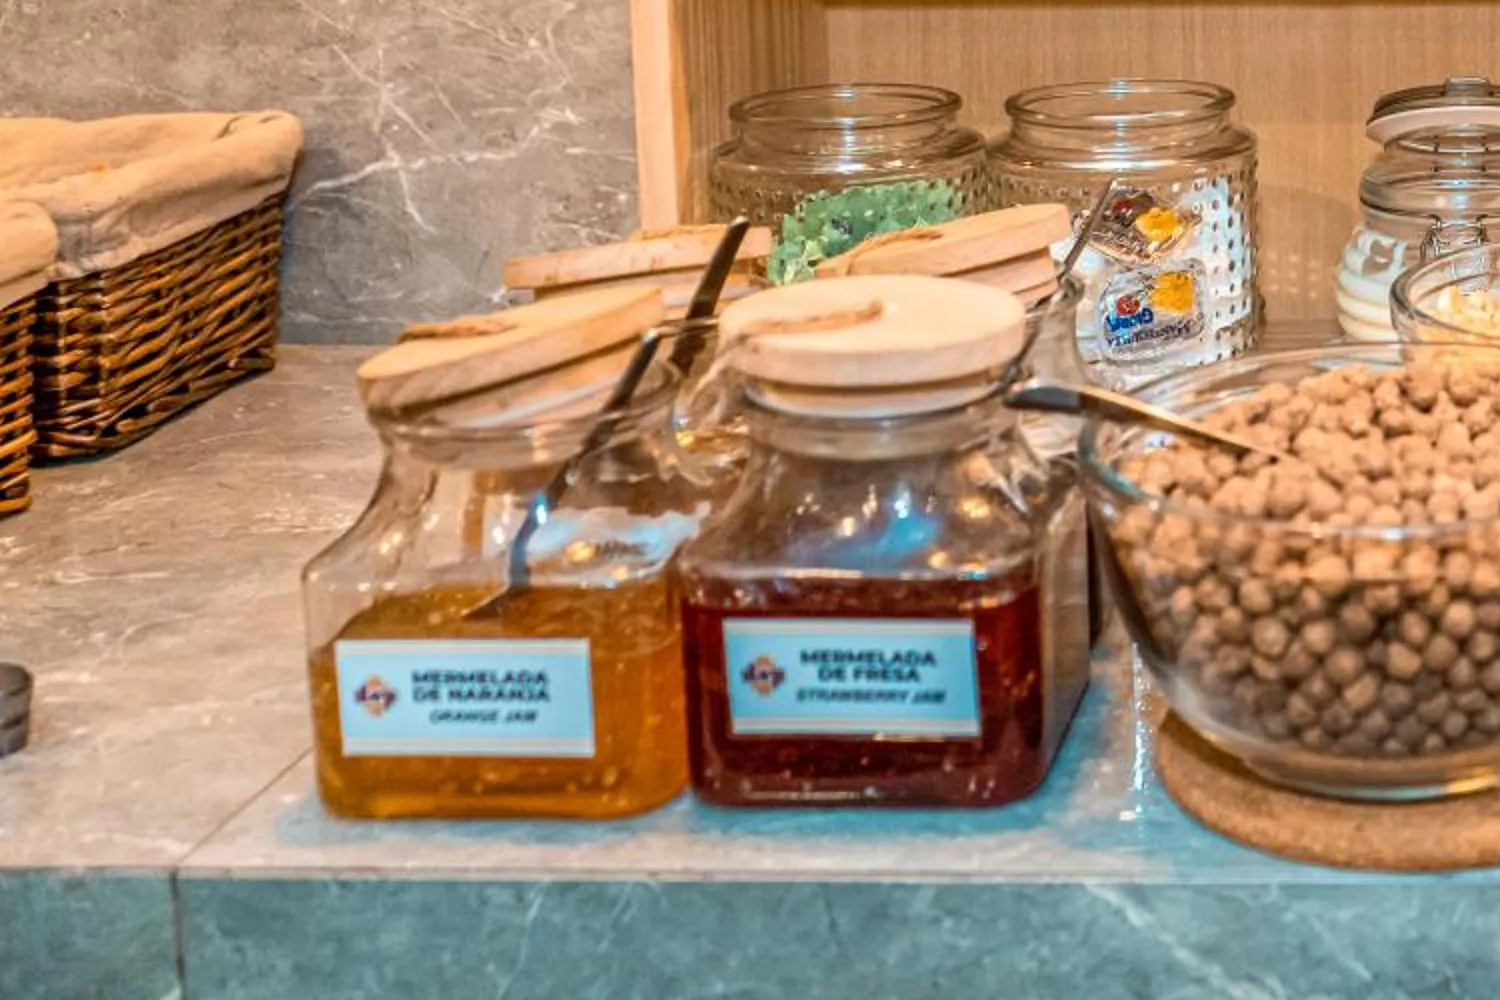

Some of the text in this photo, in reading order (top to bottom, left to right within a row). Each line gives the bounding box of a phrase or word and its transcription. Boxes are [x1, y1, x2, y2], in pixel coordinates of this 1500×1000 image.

[799, 648, 937, 667] MERMELADA
[411, 669, 550, 684] MERMELADA
[817, 665, 921, 683] DE FRESA
[412, 685, 552, 702] DE NARANJA
